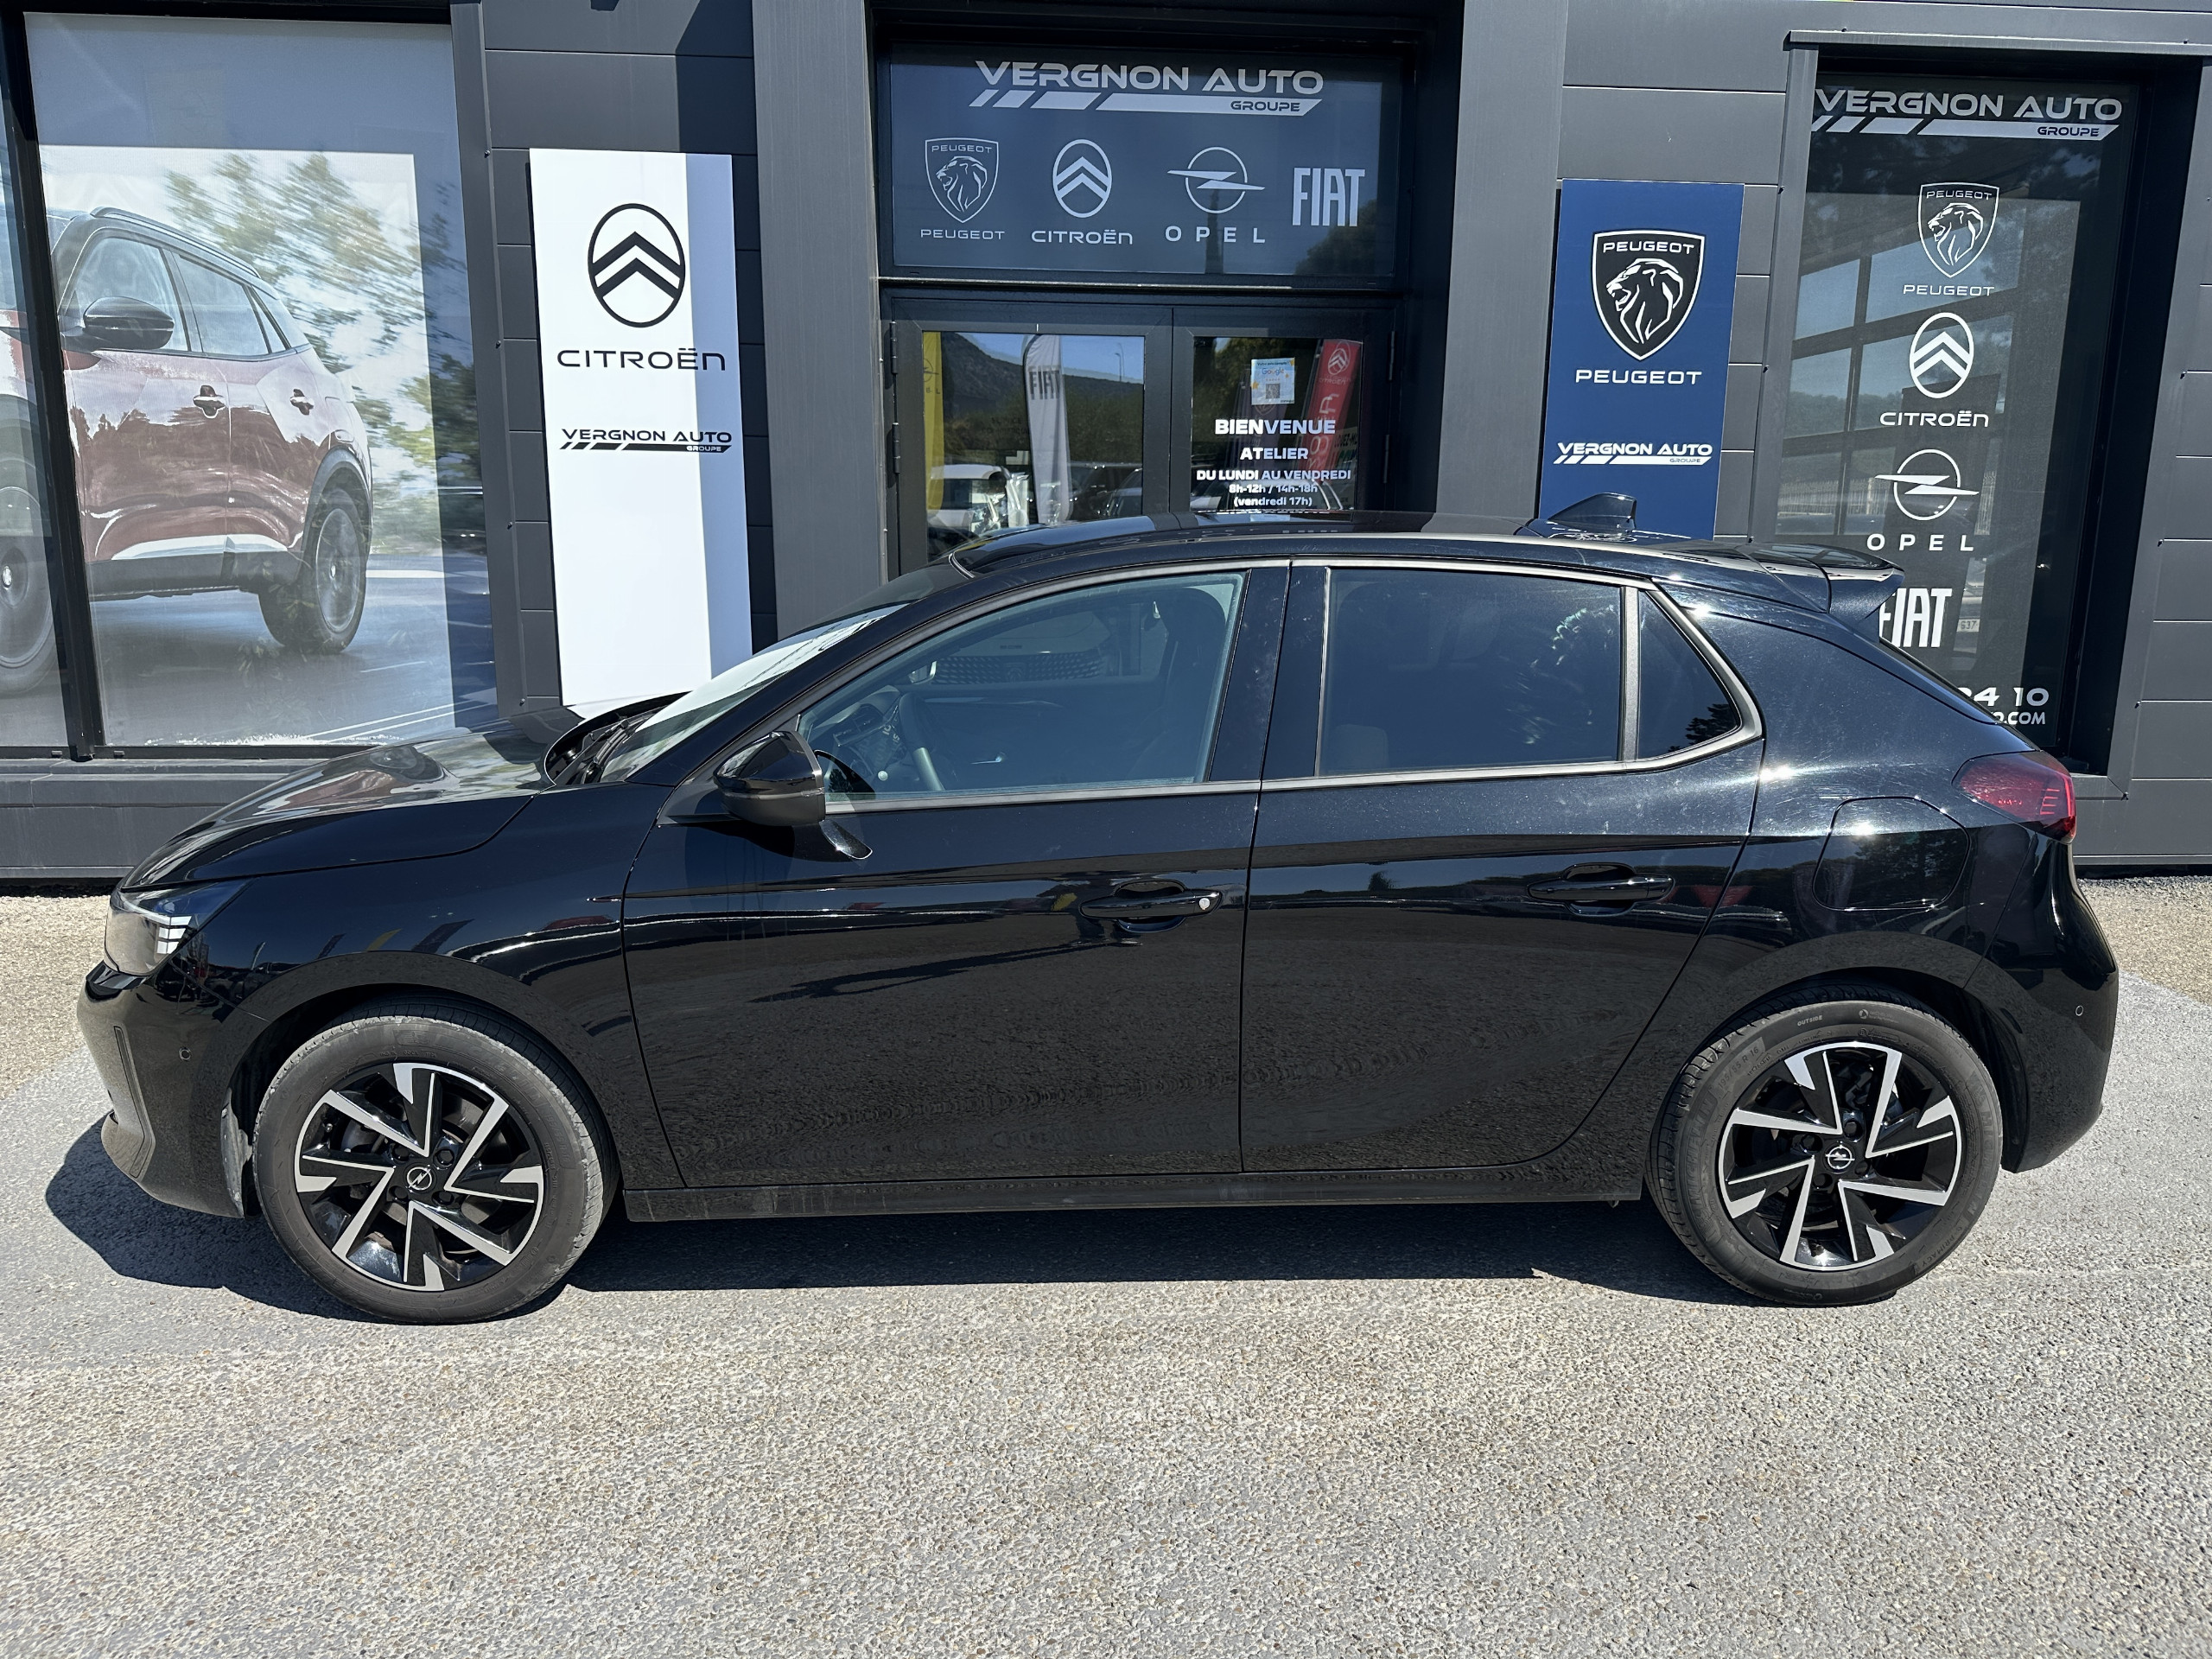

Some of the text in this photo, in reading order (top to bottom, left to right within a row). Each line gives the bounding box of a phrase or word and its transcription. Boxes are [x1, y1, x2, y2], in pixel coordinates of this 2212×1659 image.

[976, 60, 1324, 95] VERGNON AUTO
[1230, 100, 1300, 112] GROUPE
[1815, 88, 2122, 121] VERGNON AUTO
[2037, 126, 2100, 137] GROUPE
[931, 144, 993, 154] PEUGEOT
[1293, 168, 1365, 227] FIAT
[1926, 190, 1992, 200] PEUGEOT
[920, 229, 1006, 240] PEUGEOT
[1031, 229, 1133, 245] CITROËN
[1166, 226, 1265, 244] OPEL
[1602, 241, 1695, 255] PEUGEOT
[1903, 284, 1994, 296] PEUGEOT
[557, 348, 726, 371] CITROËN
[1262, 367, 1284, 376] Google
[1575, 370, 1702, 385] PEUGEOT
[1879, 410, 1989, 427] CITROËN
[1215, 419, 1336, 435] BIENVENUE
[561, 429, 732, 442] VERGNON AUTO
[1240, 447, 1309, 460] ATELIER
[1557, 442, 1713, 456] VERGNON AUTO
[1197, 470, 1351, 480] DU LUNDI AU VENDREDI
[1229, 484, 1266, 493] 8h-12h
[1276, 484, 1318, 493] 14h-18h
[1234, 496, 1313, 507] (vendredi 17h)
[1866, 533, 1974, 551] OPEL
[2013, 687, 2049, 707] 10
[1796, 1014, 1822, 1027] OUTSIDE
[1748, 1046, 1760, 1056] 16
